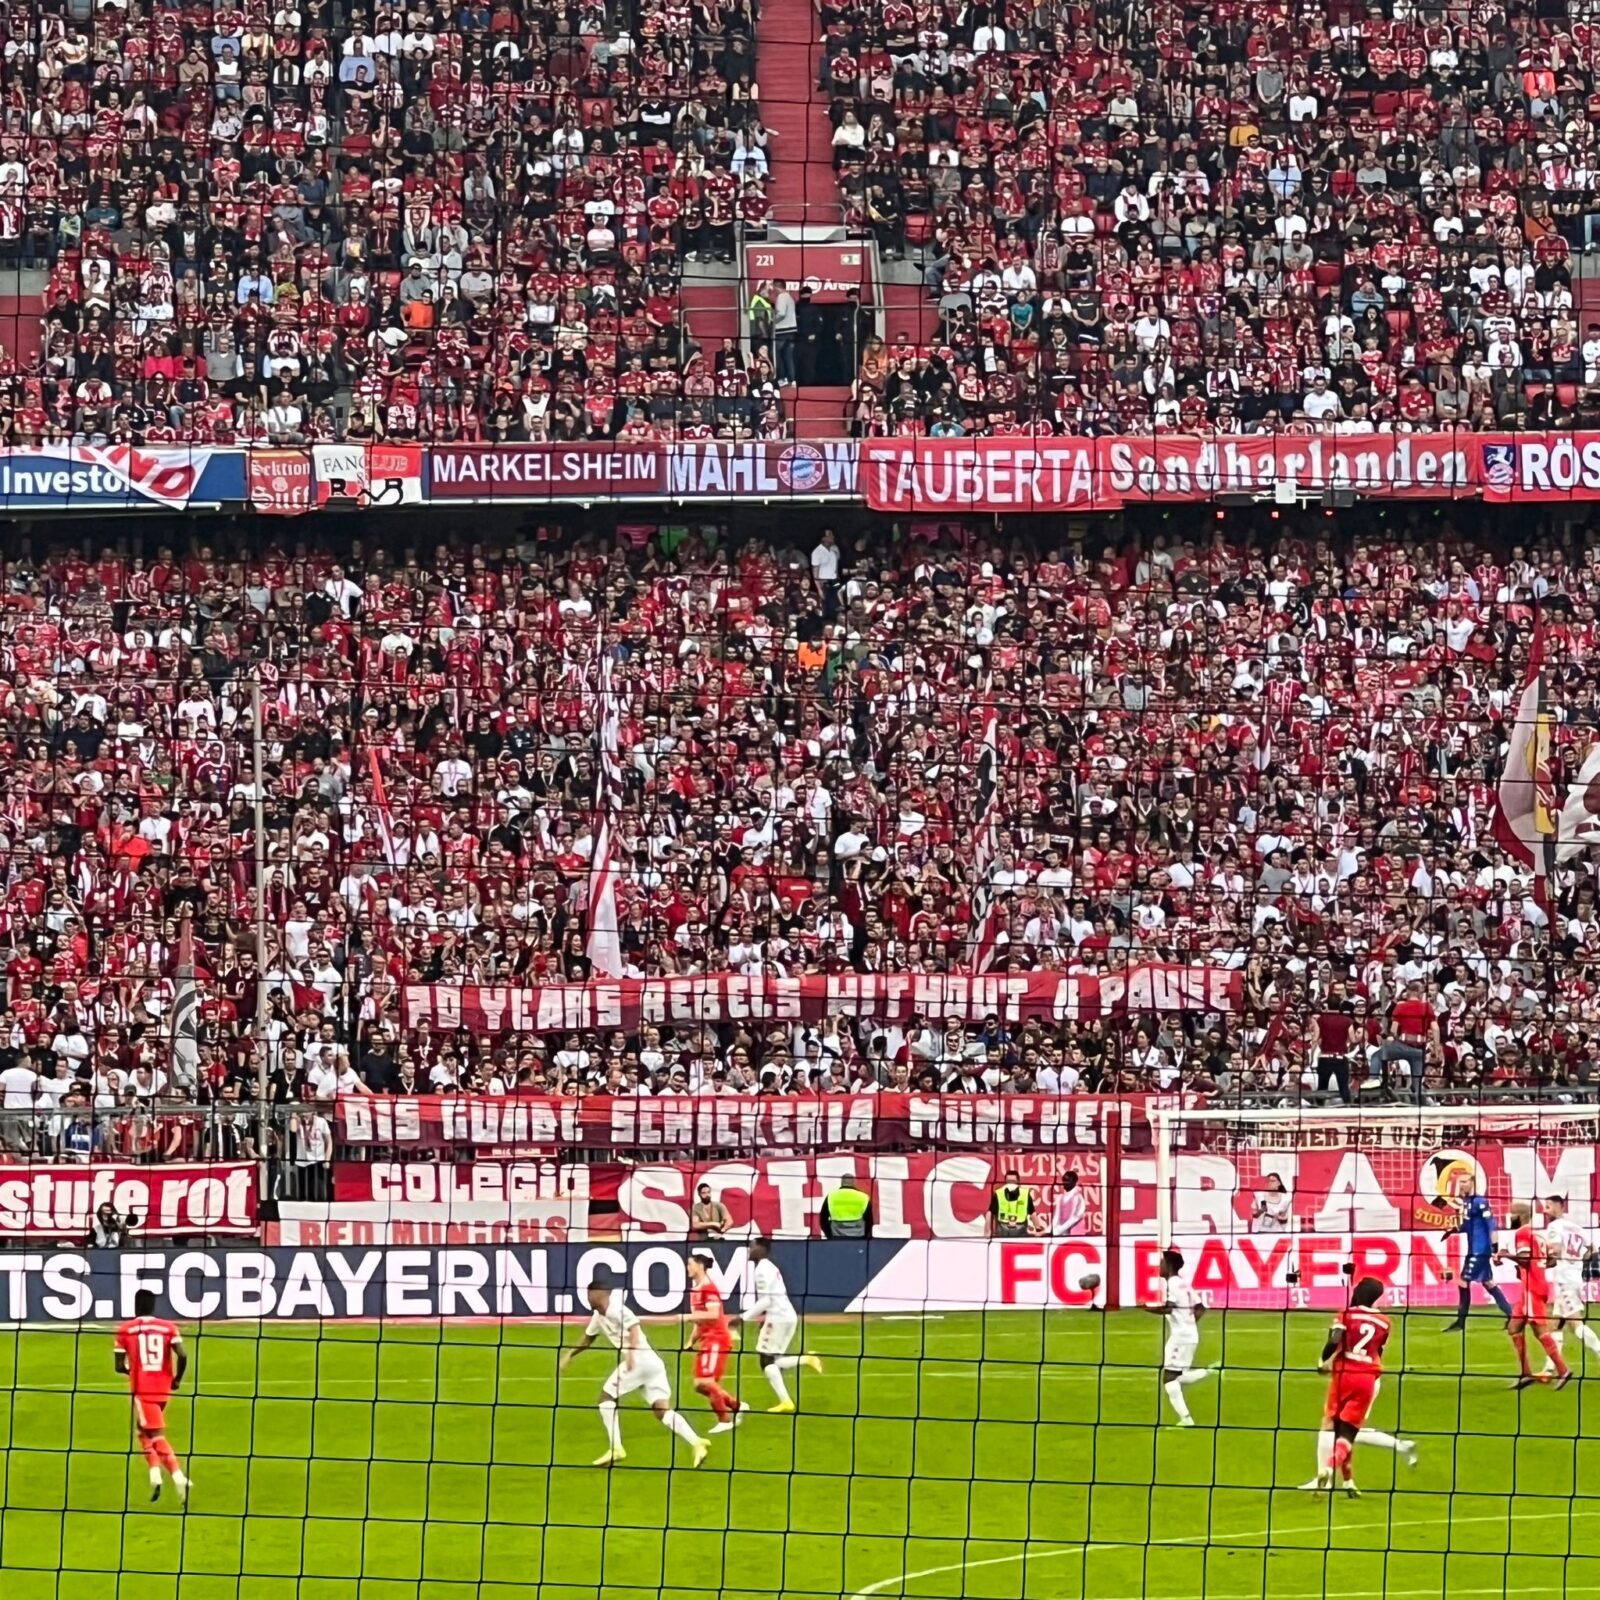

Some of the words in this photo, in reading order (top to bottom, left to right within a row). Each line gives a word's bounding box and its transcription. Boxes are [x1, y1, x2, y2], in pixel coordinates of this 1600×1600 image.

[756, 255, 774, 266] 221
[433, 452, 656, 482] MARKELSHEIM
[1110, 439, 1467, 492] Sandharlanden
[406, 986, 461, 1029] 20
[479, 985, 621, 1031] YEARS
[640, 976, 801, 1022] REBELS
[828, 975, 1028, 1021] WITHOUT
[1100, 968, 1232, 1016] PAUSE
[611, 1098, 874, 1146] SCHICKERIA
[909, 1097, 1131, 1146] MÜNCHEN
[1000, 1152, 1101, 1177] ULTRAS
[160, 1169, 252, 1227] rot
[1000, 1241, 1101, 1305] FC
[138, 1333, 164, 1366] 19
[1352, 1322, 1376, 1356] 2
